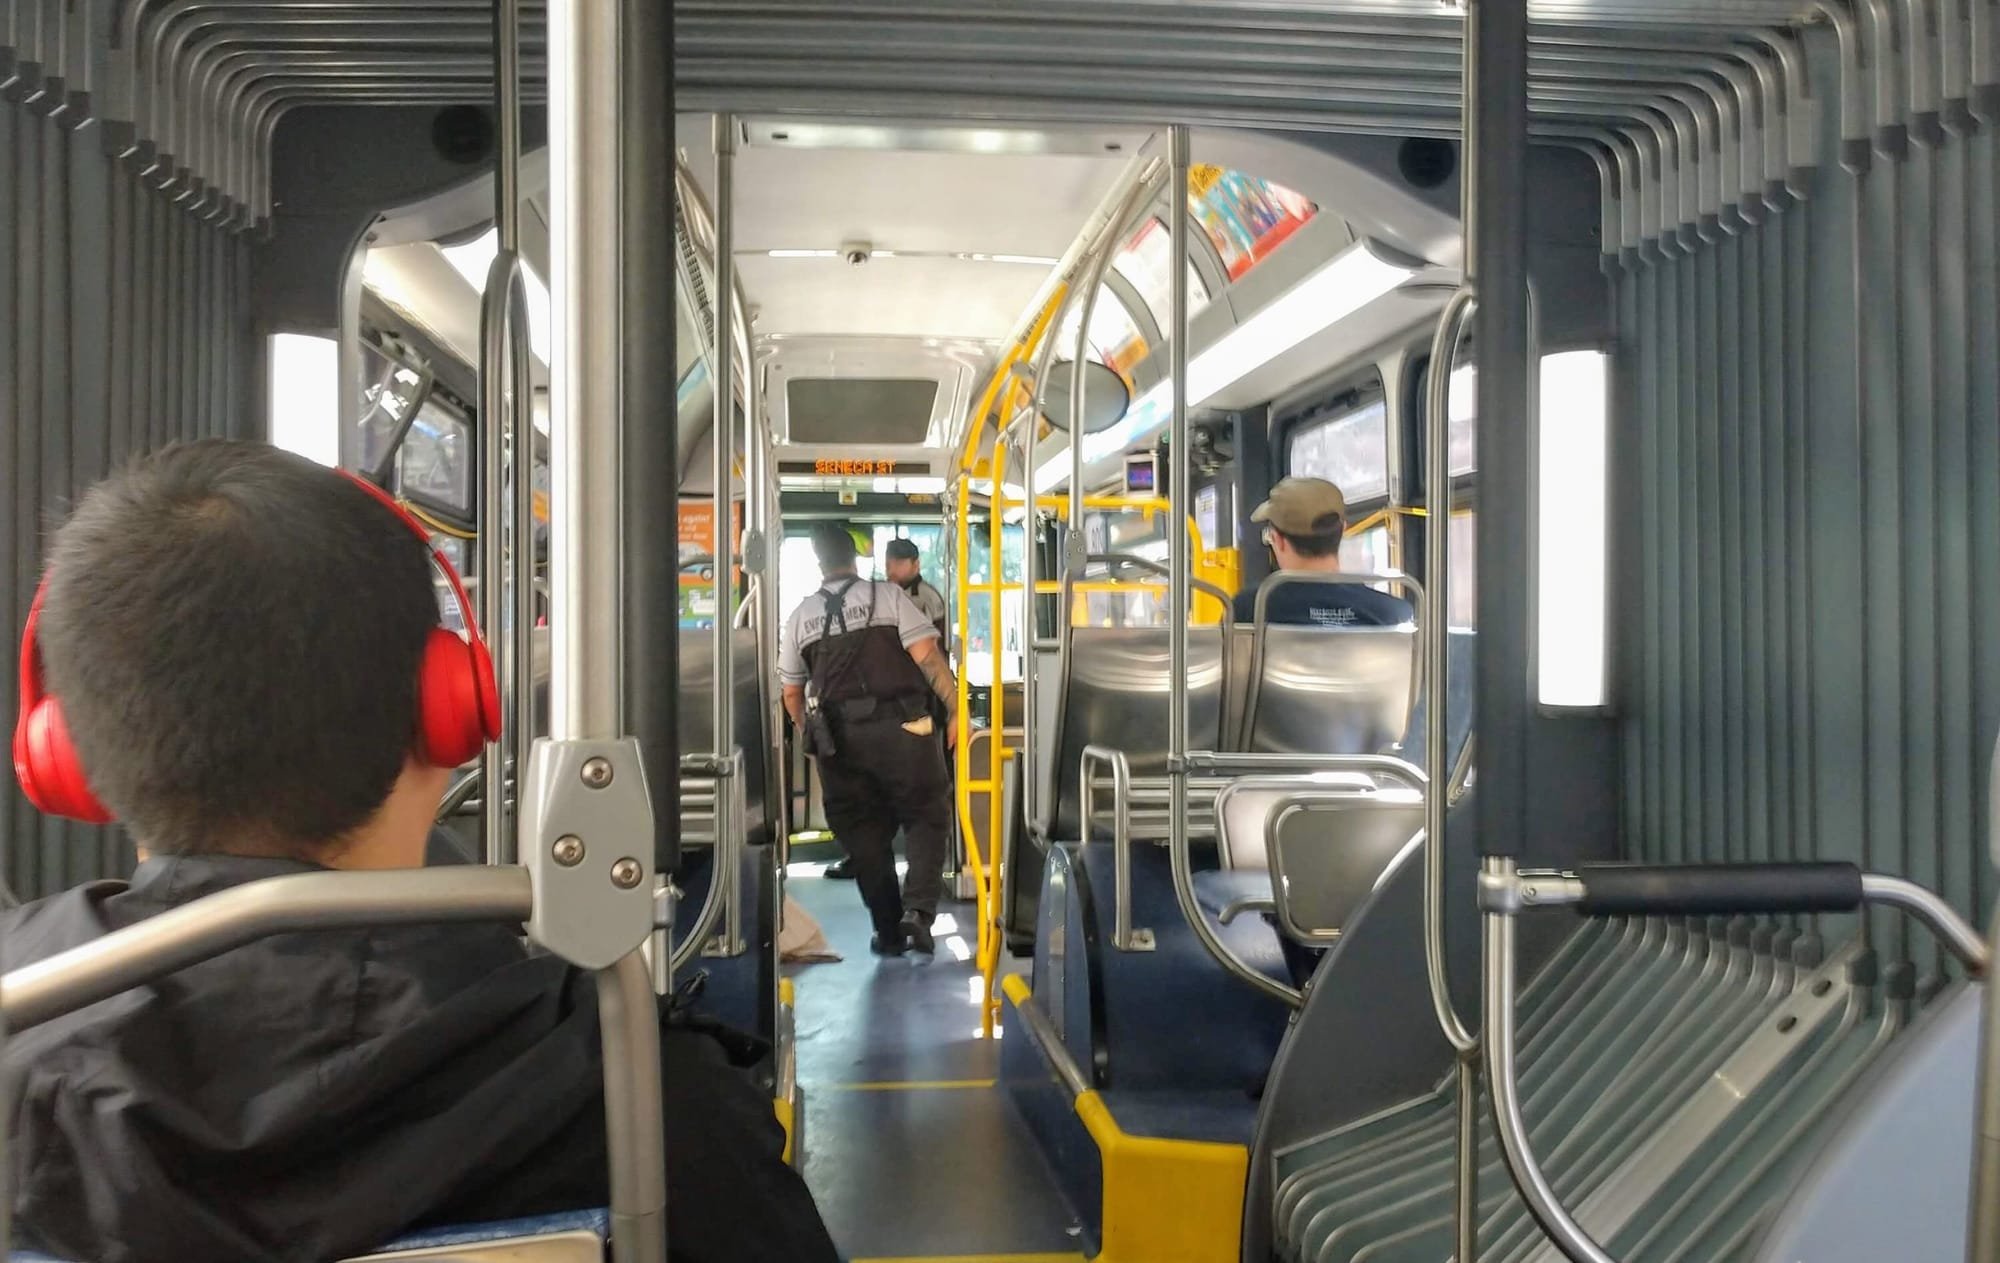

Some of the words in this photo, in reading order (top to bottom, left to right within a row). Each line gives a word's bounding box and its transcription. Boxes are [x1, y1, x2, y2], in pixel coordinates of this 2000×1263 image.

[815, 459, 873, 474] SENECA
[876, 459, 896, 474] ST
[804, 604, 873, 634] ENFOCMENT
